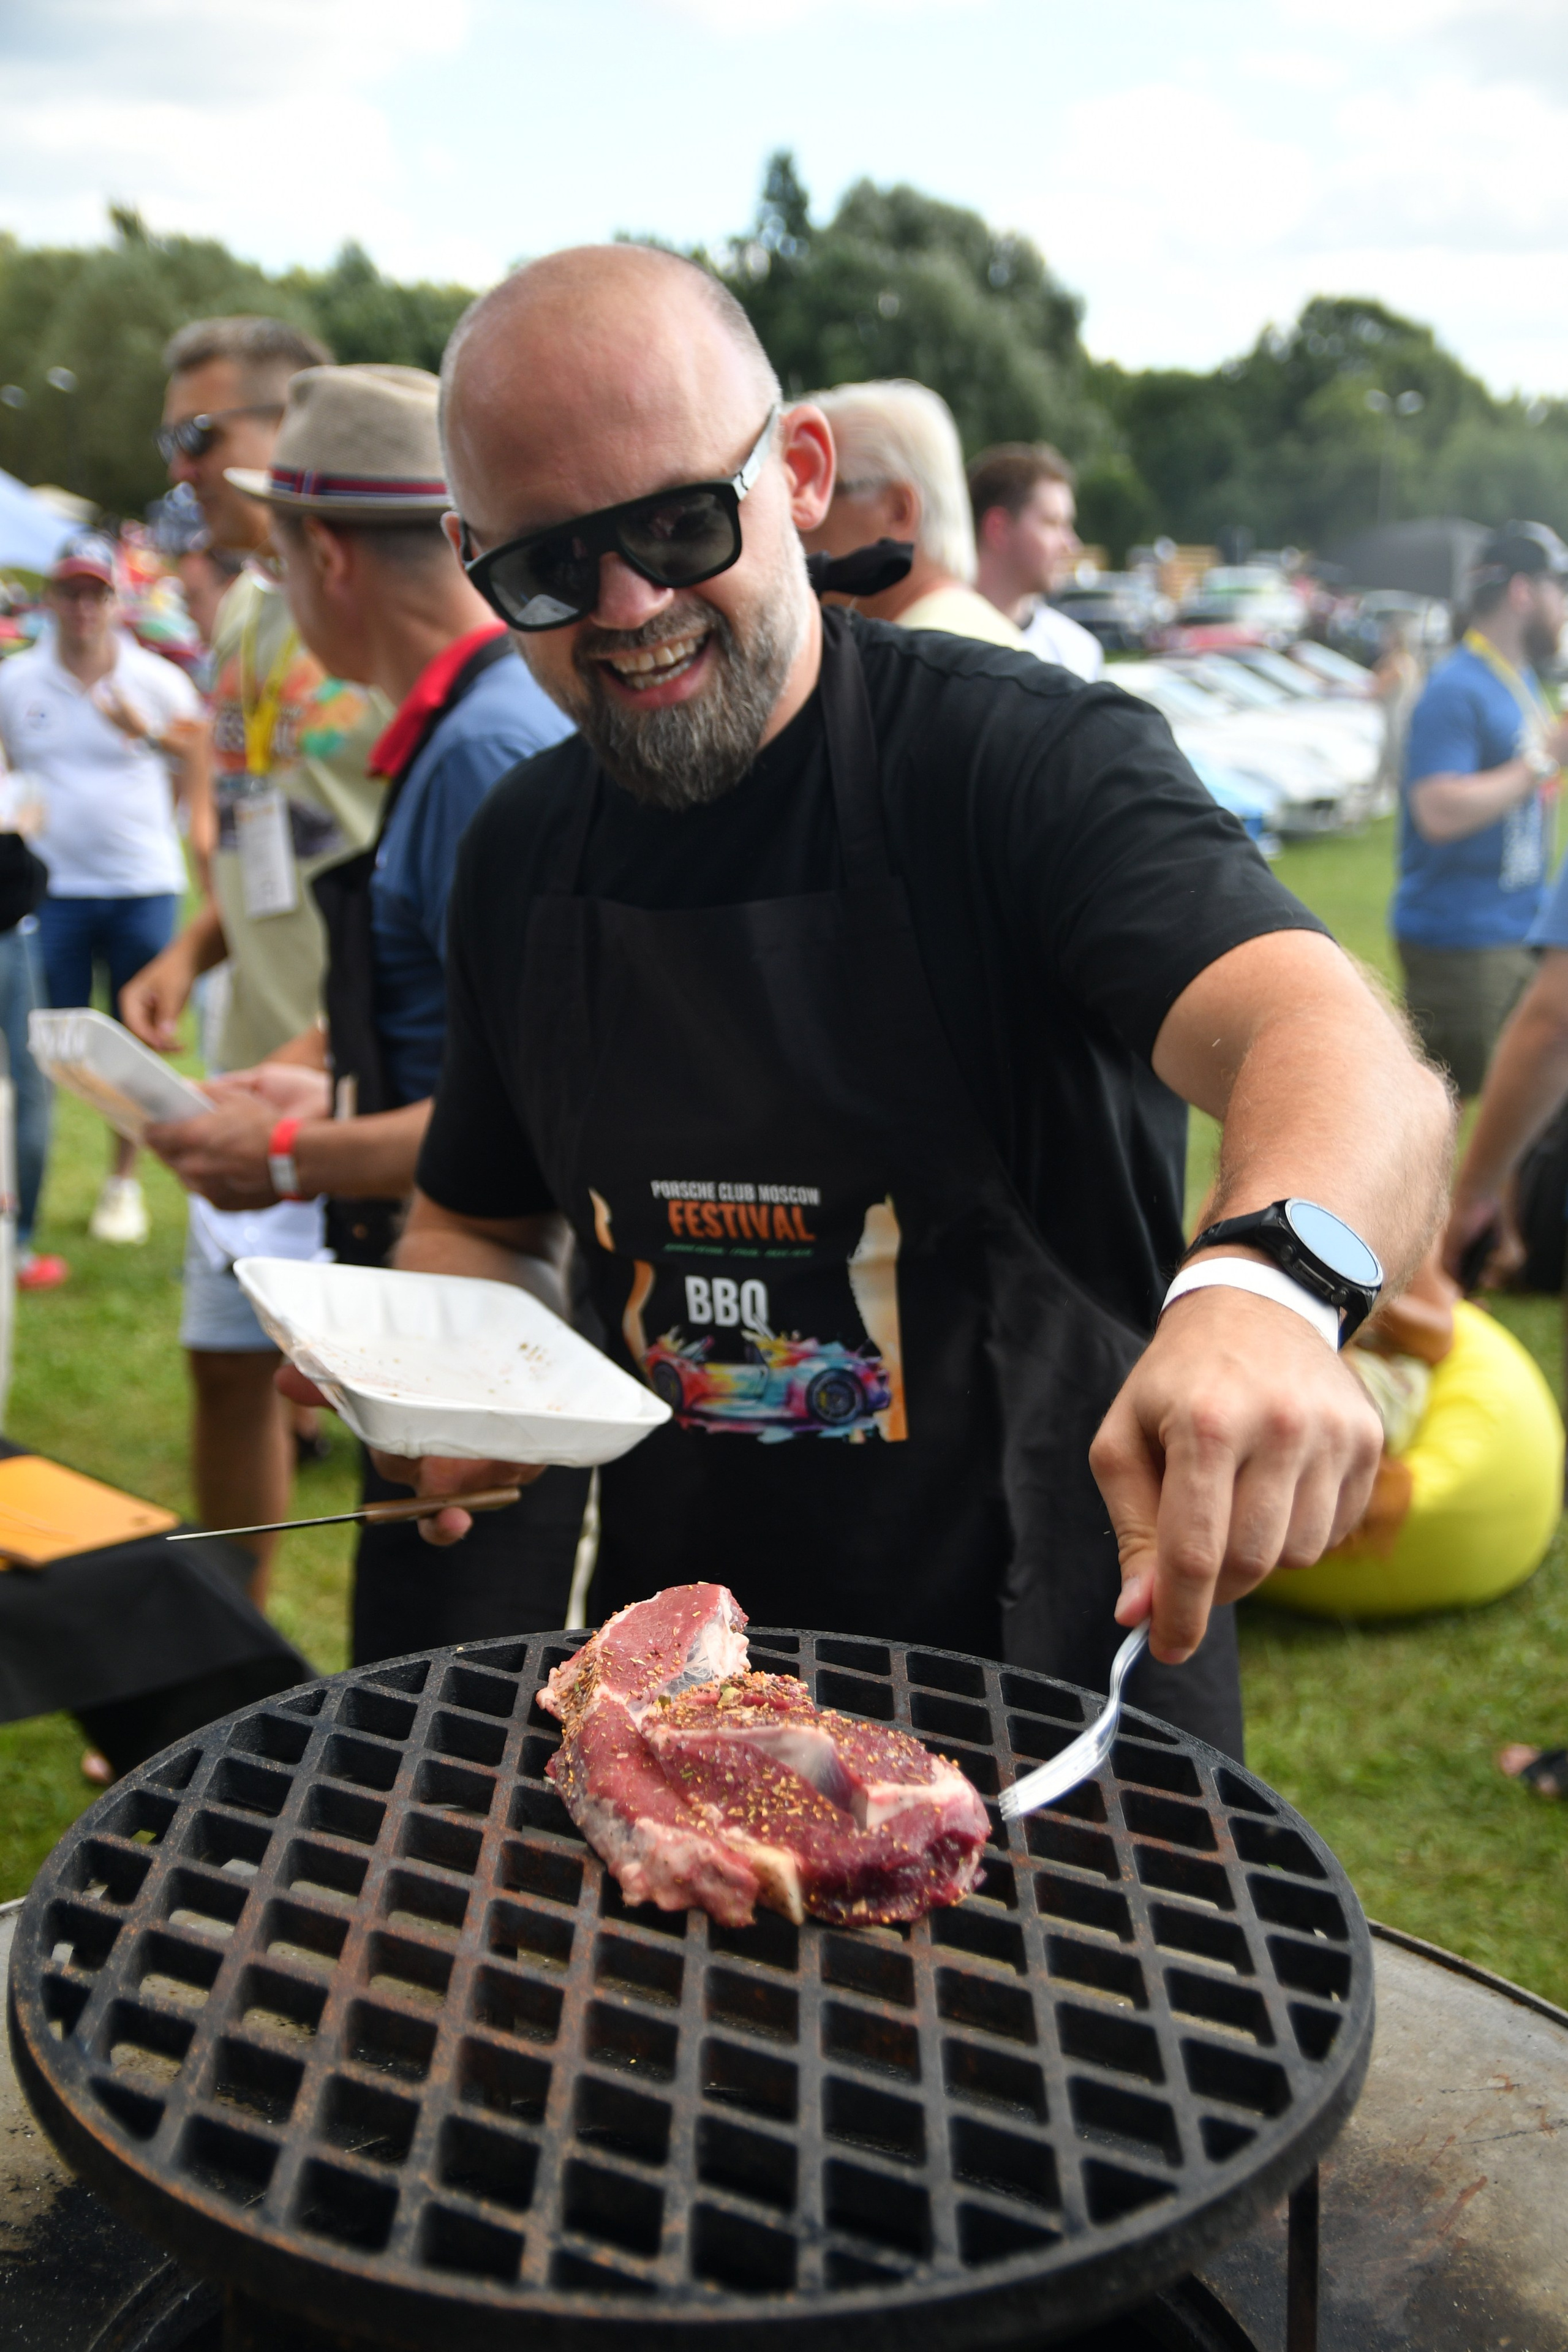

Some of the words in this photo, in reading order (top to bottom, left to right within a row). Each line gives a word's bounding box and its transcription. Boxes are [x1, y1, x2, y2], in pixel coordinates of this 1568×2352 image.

[651, 1180, 715, 1200] PORSCHE
[718, 1182, 755, 1202] CLUB
[758, 1185, 820, 1205] MOSCOW
[668, 1199, 815, 1240] FESTIVAL
[685, 1275, 775, 1340] BBQ
